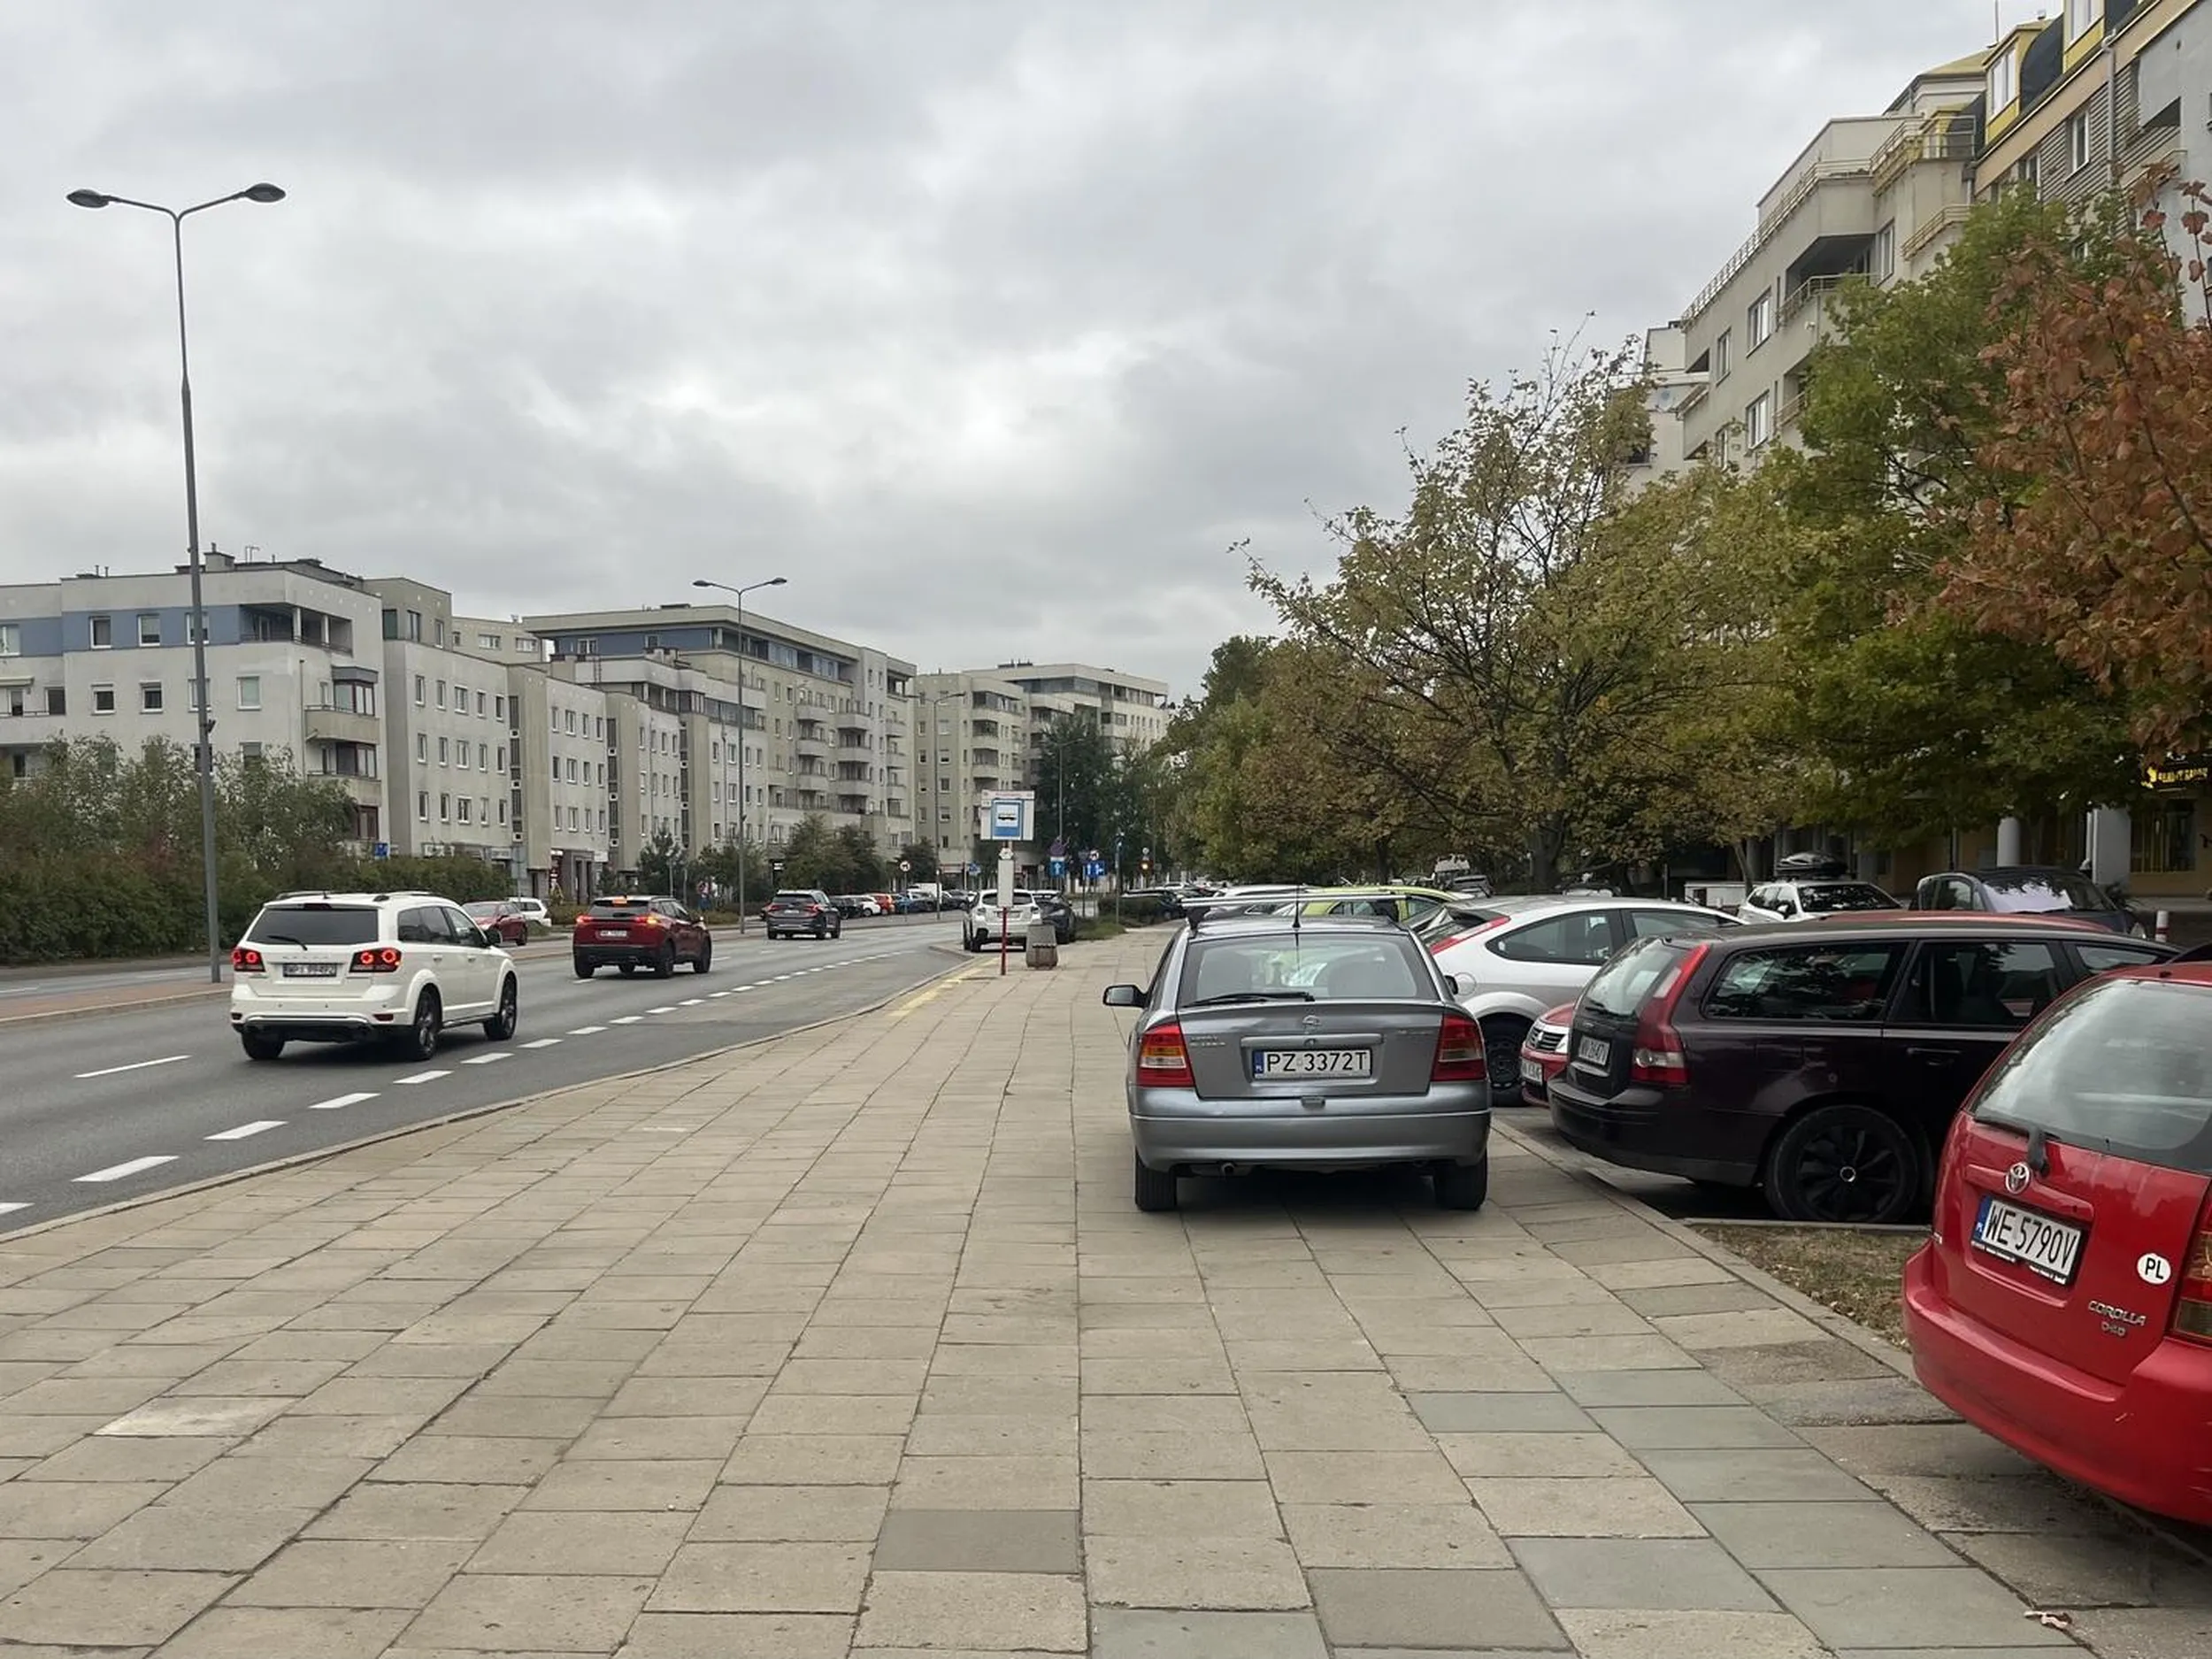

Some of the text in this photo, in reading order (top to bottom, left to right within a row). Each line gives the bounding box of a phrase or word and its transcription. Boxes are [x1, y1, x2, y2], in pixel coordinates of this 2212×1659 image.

[1266, 1051, 1368, 1071] PZ 3372T
[1985, 1204, 2078, 1270] WE 5790V
[2145, 1256, 2164, 1280] PL
[2088, 1300, 2147, 1326] COROLLA
